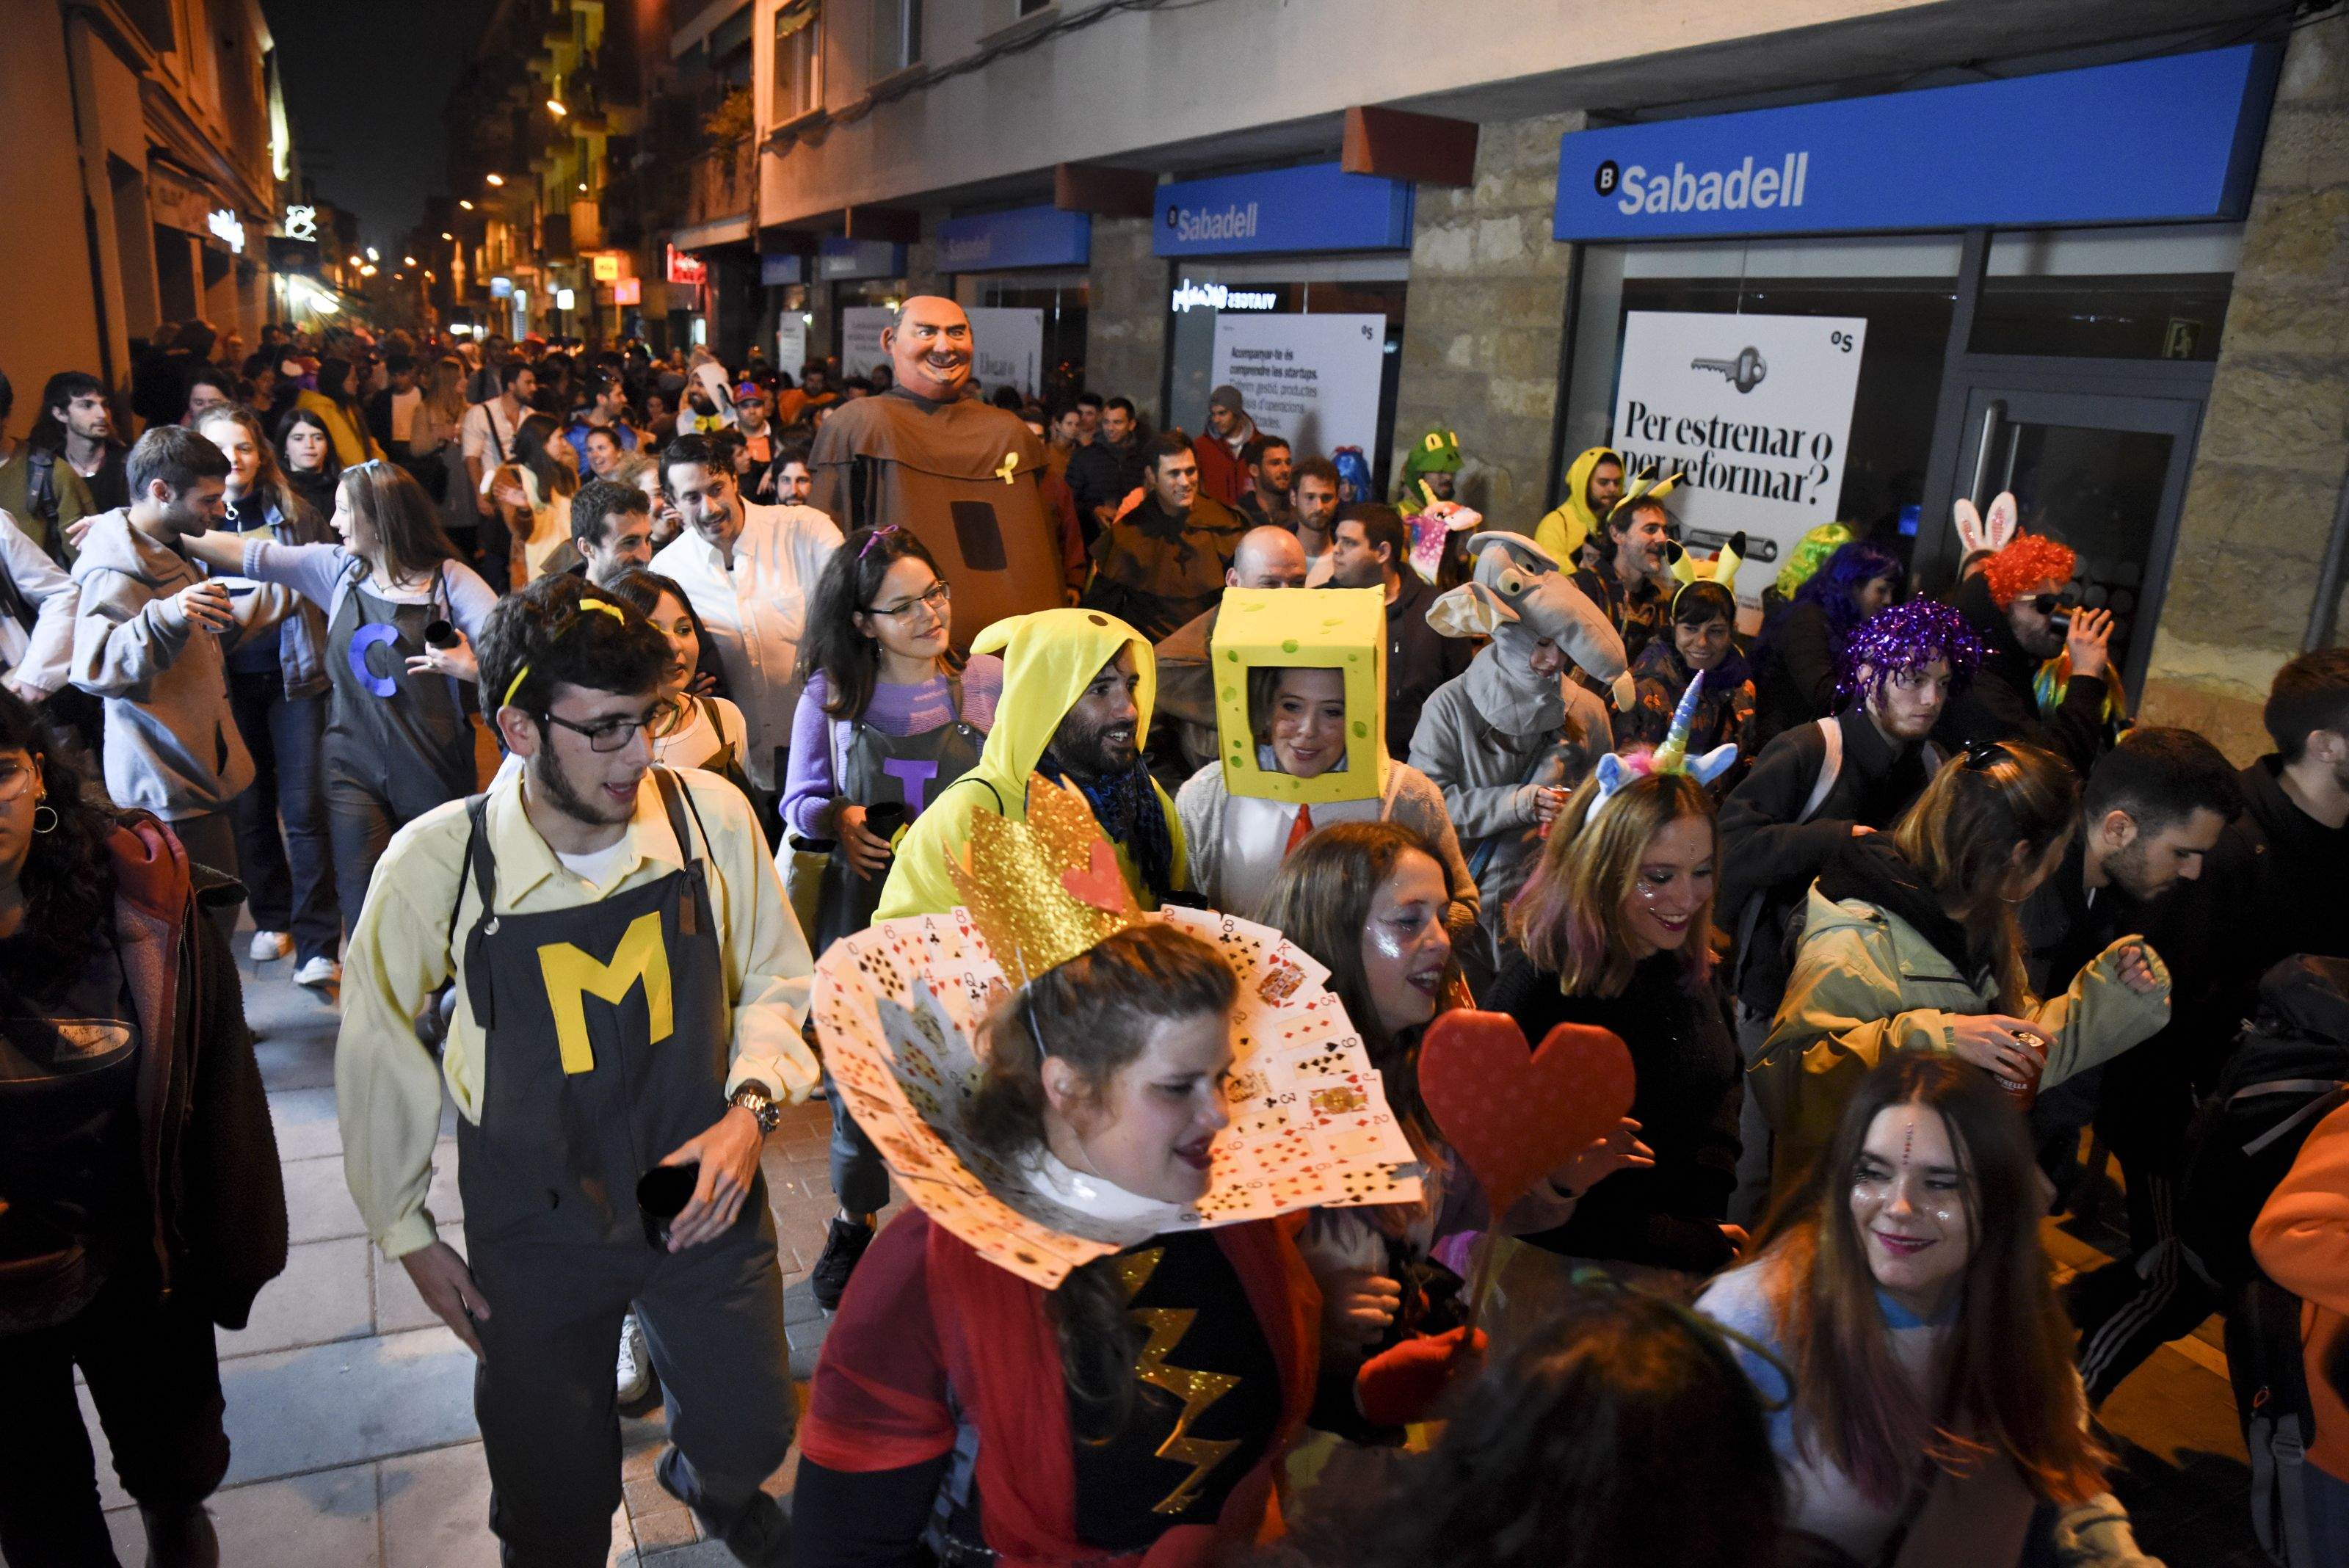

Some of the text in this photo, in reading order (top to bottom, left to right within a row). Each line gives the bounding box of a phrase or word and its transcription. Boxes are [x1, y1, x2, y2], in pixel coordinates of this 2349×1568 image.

[1600, 151, 1808, 215] B Sabadell
[1177, 202, 1257, 242] Sabadell
[1624, 401, 1833, 462] Per estrenar o
[1670, 450, 1829, 505] reformar?
[348, 623, 399, 697] C
[882, 757, 939, 824] T
[925, 917, 937, 929] A
[955, 910, 966, 923] 8
[884, 925, 896, 939] 6
[1222, 919, 1234, 932] 8
[1277, 943, 1292, 956] K
[924, 968, 934, 982] 4
[964, 972, 978, 987] Q
[537, 910, 673, 1075] M
[1321, 995, 1336, 1006] 3
[1279, 1092, 1297, 1104] 3
[1373, 1114, 1390, 1125] 2
